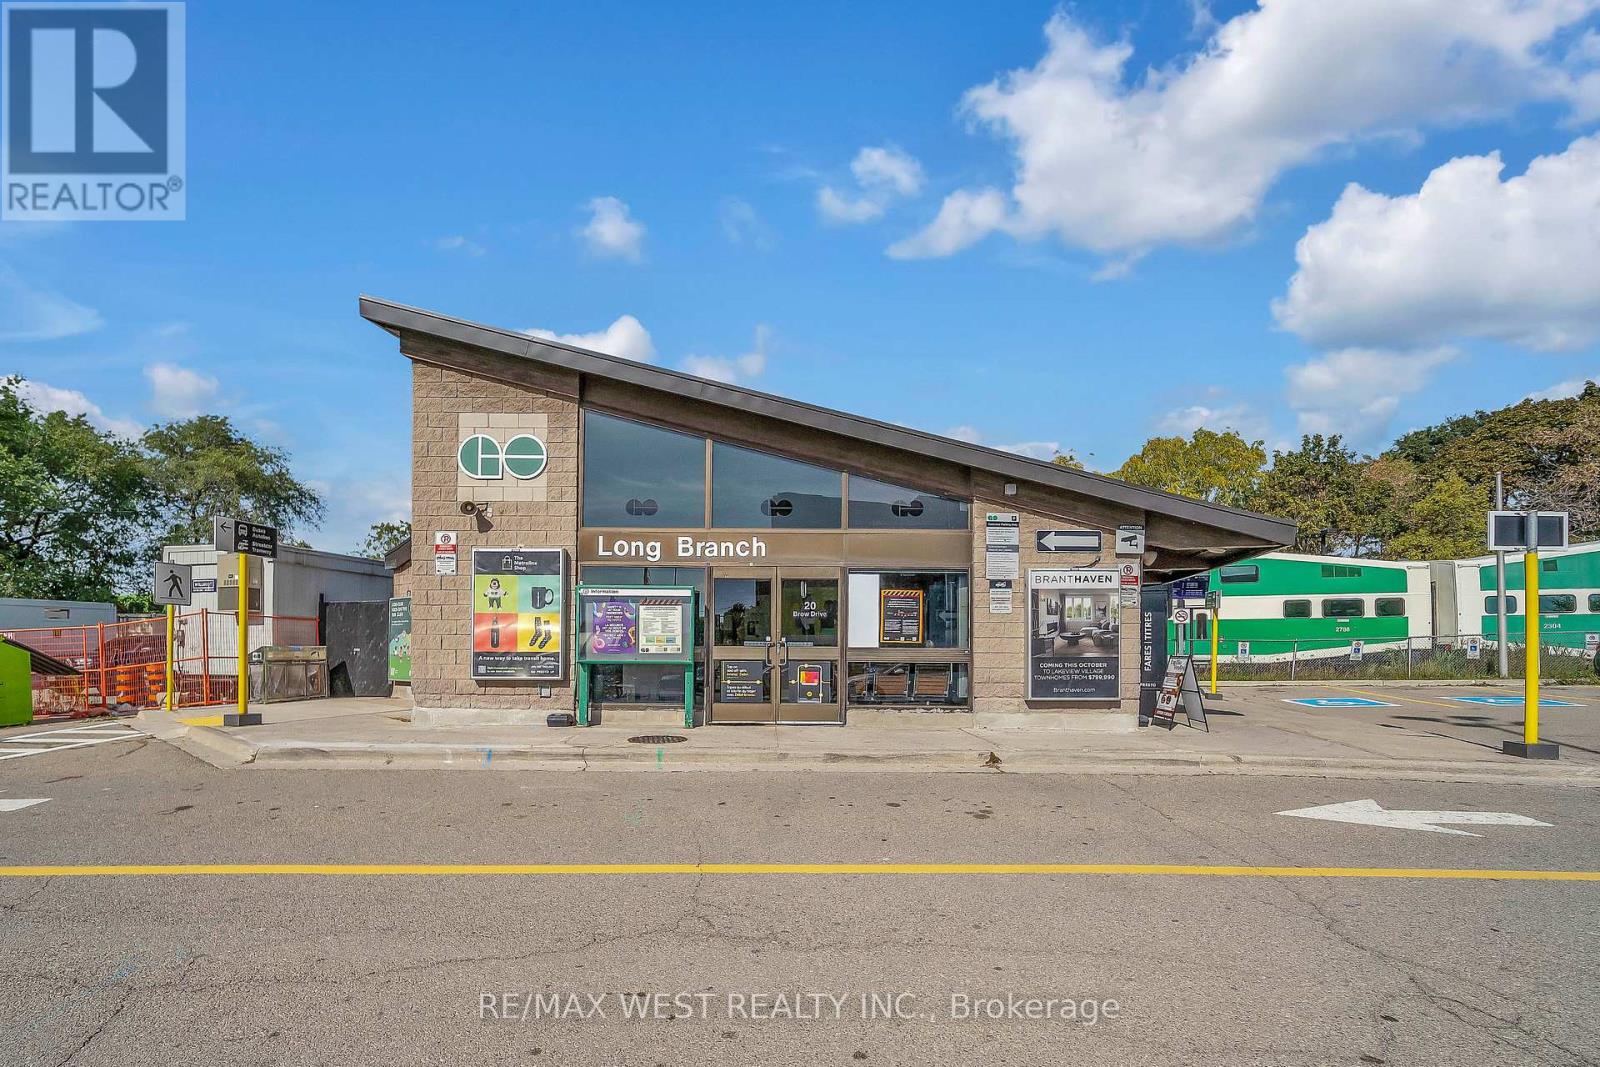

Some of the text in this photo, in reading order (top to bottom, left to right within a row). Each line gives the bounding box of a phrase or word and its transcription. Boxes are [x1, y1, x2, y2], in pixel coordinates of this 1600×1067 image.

[598, 535, 766, 562] Long Branch
[1035, 575, 1112, 584] BRANTHAVEN
[804, 601, 817, 610] 20
[1144, 612, 1152, 672] FARES TITRES
